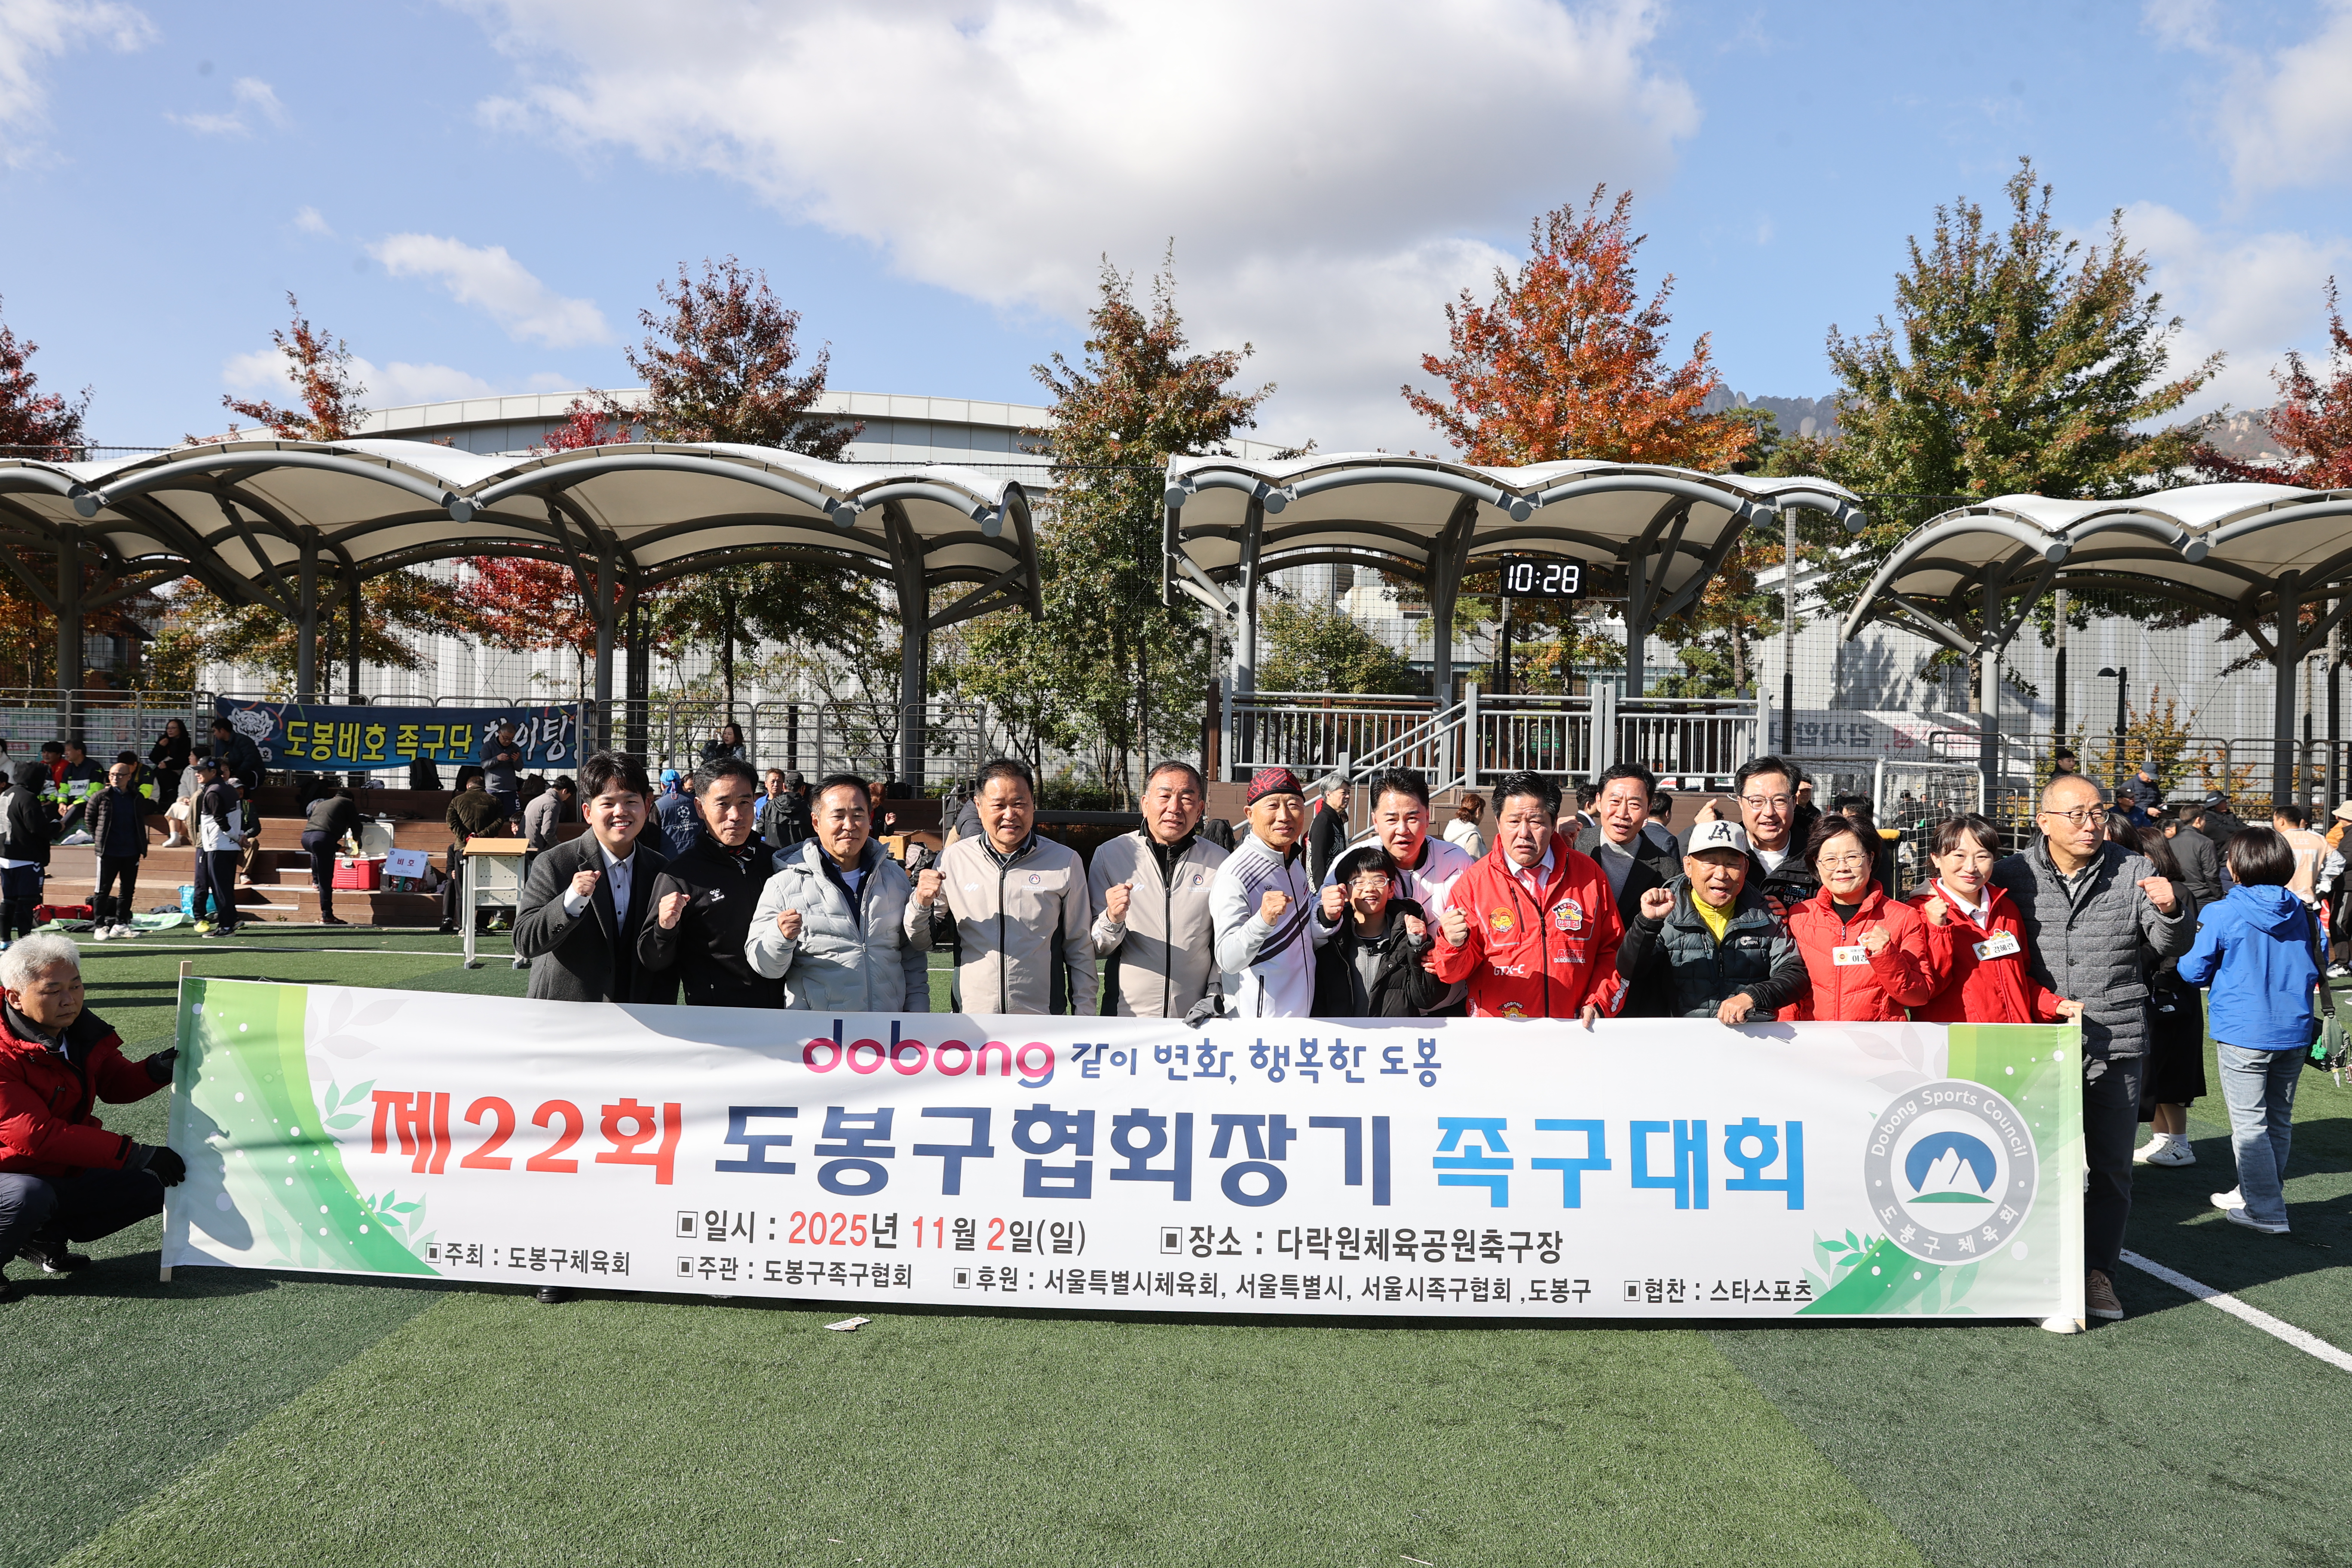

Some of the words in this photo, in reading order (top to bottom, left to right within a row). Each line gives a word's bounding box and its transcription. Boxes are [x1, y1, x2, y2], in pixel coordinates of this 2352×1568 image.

[1508, 564, 1580, 593] 10:28
[284, 721, 386, 763] 도봉비호
[395, 724, 473, 760] 족구단
[672, 822, 698, 830] CHAMPIONS
[1557, 919, 1579, 928] 안병건
[1992, 943, 2015, 953] 강혜란
[1494, 964, 1525, 976] GTX-C
[802, 1019, 1055, 1087] dobong
[1070, 1043, 1137, 1079] 같이
[1154, 1038, 1237, 1085] 변화,
[1249, 1038, 1366, 1084] 행복한
[1380, 1038, 1442, 1088] 도봉
[1871, 1099, 1918, 1157] Dobong
[1922, 1090, 1978, 1106] Sports
[1983, 1099, 2028, 1157] Council
[371, 1090, 682, 1185] 제22회
[715, 1103, 1391, 1207] 도봉구협회장기
[1433, 1117, 1804, 1210] 족구대회
[705, 1210, 755, 1243] 일시
[788, 1211, 898, 1249] 2025년
[913, 1216, 976, 1251] 11월
[987, 1217, 1085, 1256] 2일(일)
[1188, 1225, 1242, 1258] 장소
[1277, 1226, 1563, 1264] 다락원체육공원축구장
[445, 1243, 483, 1268] 주최
[508, 1246, 629, 1276] 도봉구체육회
[698, 1256, 739, 1281] 주관
[763, 1259, 912, 1289] 도봉구족구협회
[976, 1266, 1017, 1292] 후원
[1044, 1268, 1226, 1300] 서울특별시체육회,
[1235, 1273, 1351, 1302] 서울특별시,
[1361, 1276, 1510, 1303] 서울시족구협회
[1645, 1278, 1686, 1303] 협찬
[1710, 1279, 1813, 1303] 스타스포츠
